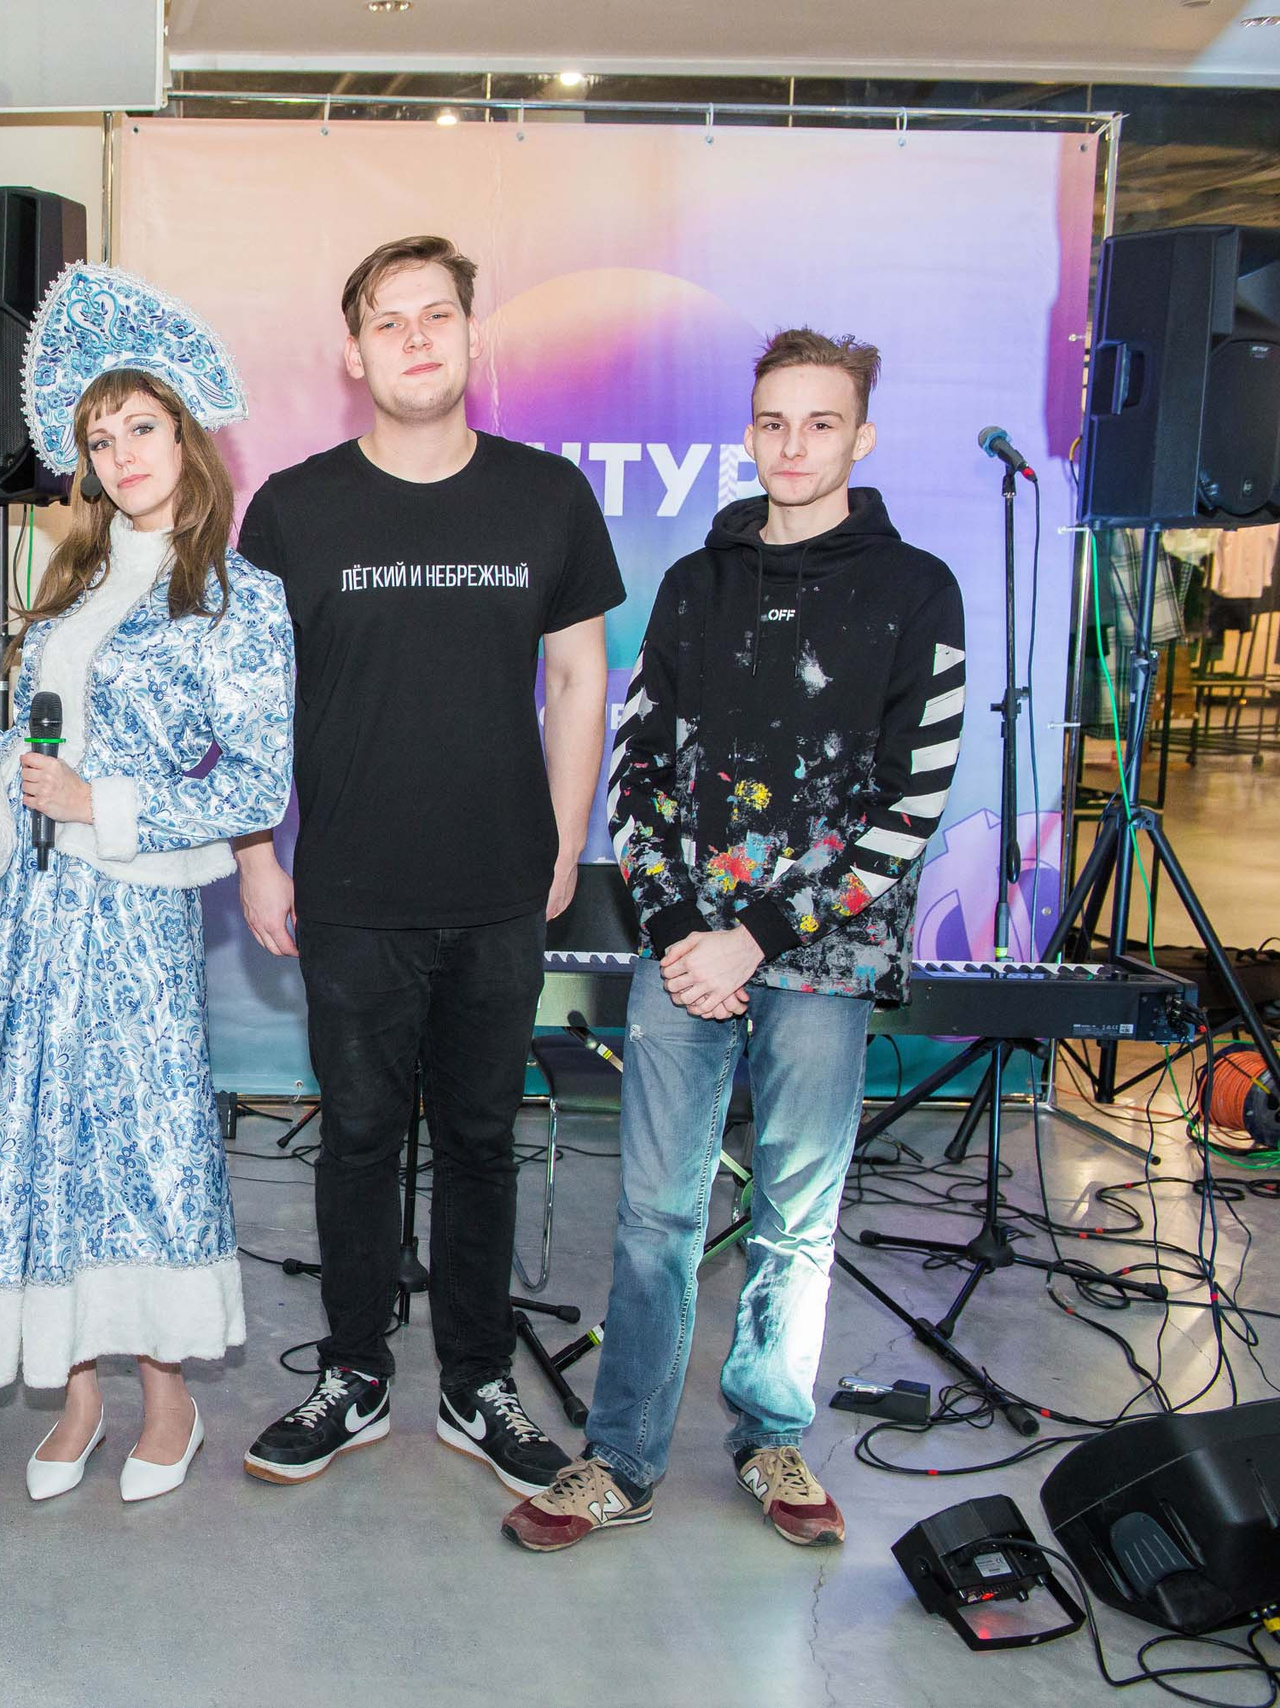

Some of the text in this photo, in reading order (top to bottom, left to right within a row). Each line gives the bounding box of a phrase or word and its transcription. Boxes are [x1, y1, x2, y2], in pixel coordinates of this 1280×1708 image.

[341, 561, 529, 592] ЛЁГКИЙ И НЕБРЕЖНЫЙ
[768, 608, 796, 622] OFF
